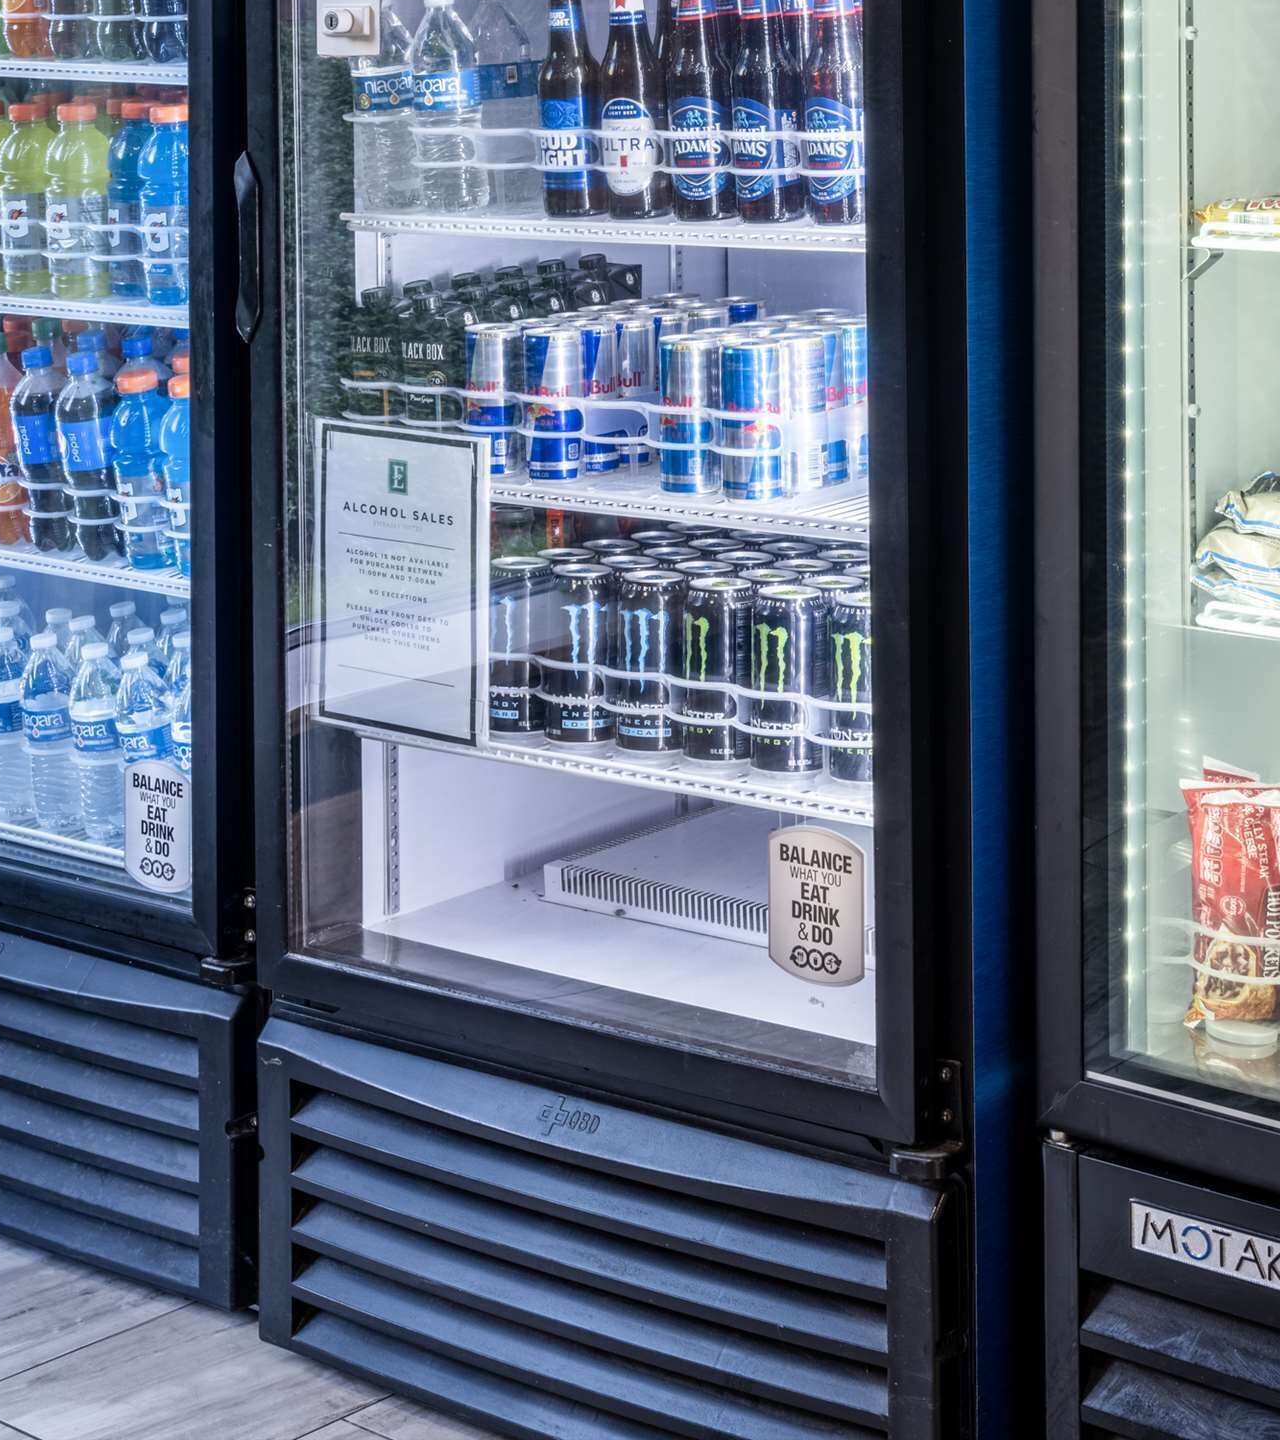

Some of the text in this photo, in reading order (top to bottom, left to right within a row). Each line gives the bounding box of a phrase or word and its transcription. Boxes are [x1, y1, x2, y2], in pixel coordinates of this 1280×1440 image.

[364, 75, 413, 96] niagar
[674, 139, 722, 157] ADAMS
[351, 335, 391, 353] LACK BOX
[402, 340, 446, 361] LACK BOX
[19, 426, 32, 455] pepsi
[68, 433, 81, 462] pepsi
[343, 501, 407, 519] ALCOHOL
[412, 511, 455, 526] SALES
[346, 548, 378, 559] ALCOHOL
[391, 554, 406, 562] NOT
[409, 556, 450, 569] AVAILABLE
[350, 557, 364, 565] FOR
[407, 566, 444, 578] BETWEEN
[390, 572, 405, 582] AND
[381, 590, 428, 604] EXCEPTIONS
[391, 611, 416, 622] FRONT
[133, 773, 183, 798] BALANCE
[140, 791, 176, 809] WHAT YOU
[141, 820, 174, 842] DRINK
[145, 838, 170, 857] & DO
[779, 843, 853, 875] BALANCE
[1258, 845, 1270, 879] STEAK
[789, 866, 842, 887] WHAT YOU
[791, 900, 840, 928] DRINK
[798, 922, 833, 946] & DO
